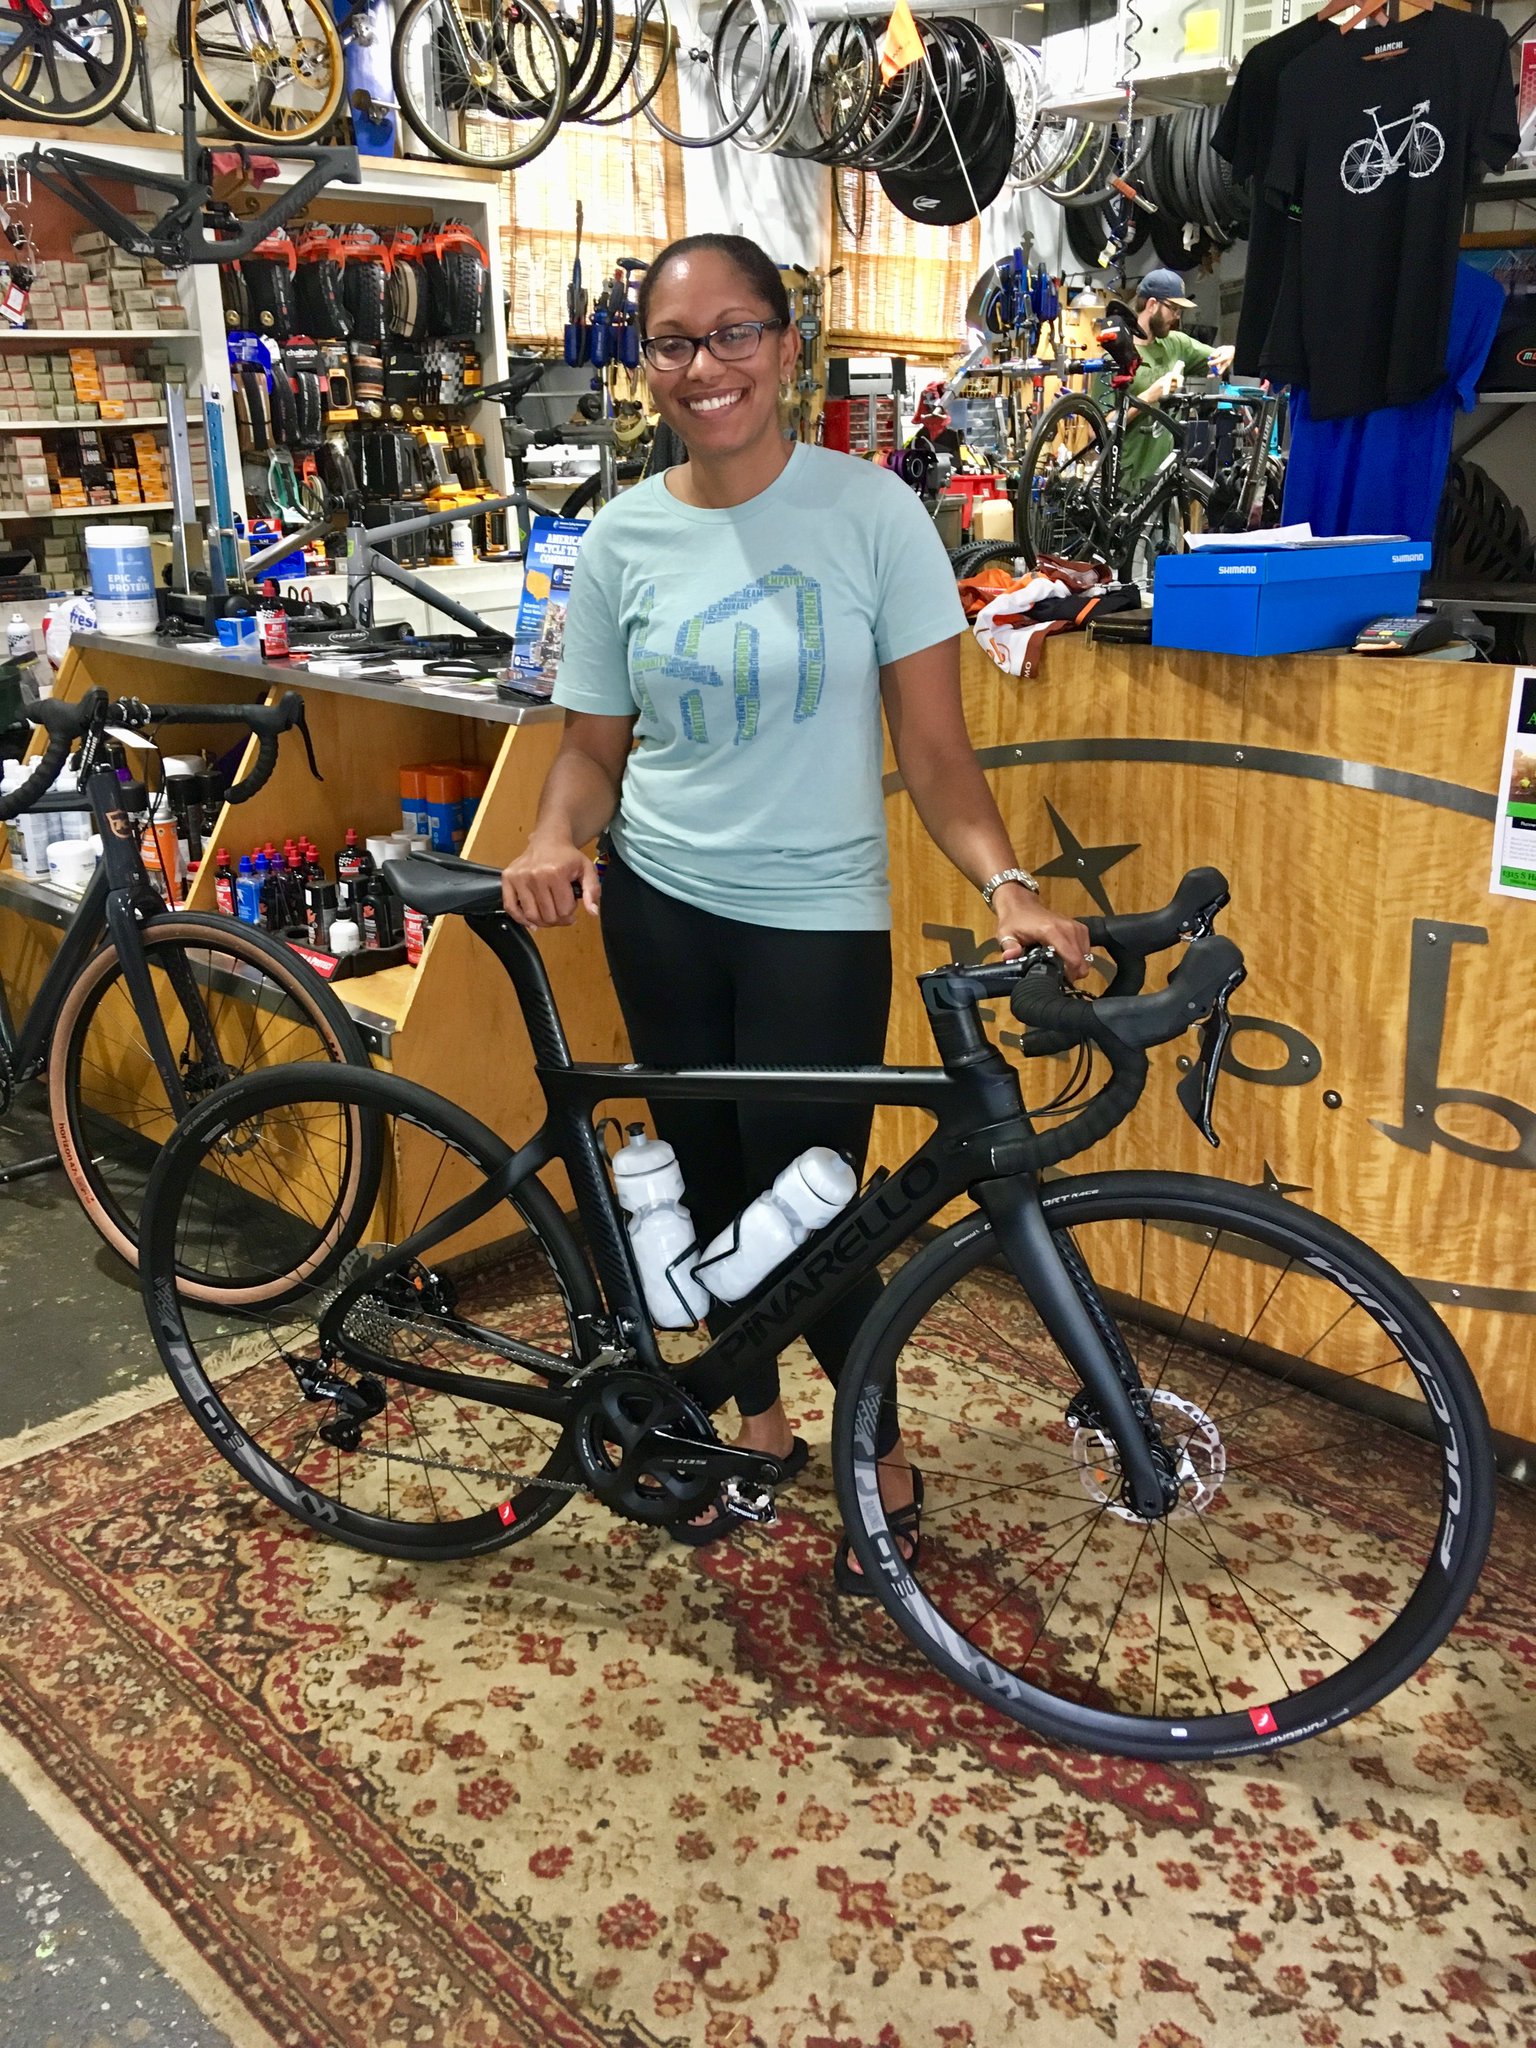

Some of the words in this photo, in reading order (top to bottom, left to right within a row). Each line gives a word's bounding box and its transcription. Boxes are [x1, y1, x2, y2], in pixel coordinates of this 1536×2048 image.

[1375, 41, 1403, 54] BIANCHI
[286, 348, 319, 357] challenge
[1391, 553, 1424, 563] SHIMANO
[1218, 565, 1257, 575] SHIMANO
[107, 574, 132, 583] EPIC
[764, 575, 805, 587] EMPATHY
[109, 583, 150, 592] PROTEIN
[742, 588, 763, 598] TEAM
[718, 602, 749, 611] COURAGE
[804, 589, 820, 648] BETTERMENT
[685, 618, 703, 657] PASSION
[736, 627, 750, 695] RESPONSIBILITY
[1502, 870, 1519, 880] 1315
[58, 1122, 74, 1163] horizon
[1071, 1189, 1099, 1199] RACE
[953, 1230, 976, 1248] Continental
[717, 1157, 939, 1367] PINARELLO
[1303, 1256, 1461, 1570] FULCRUM
[862, 1500, 884, 1530] RACING
